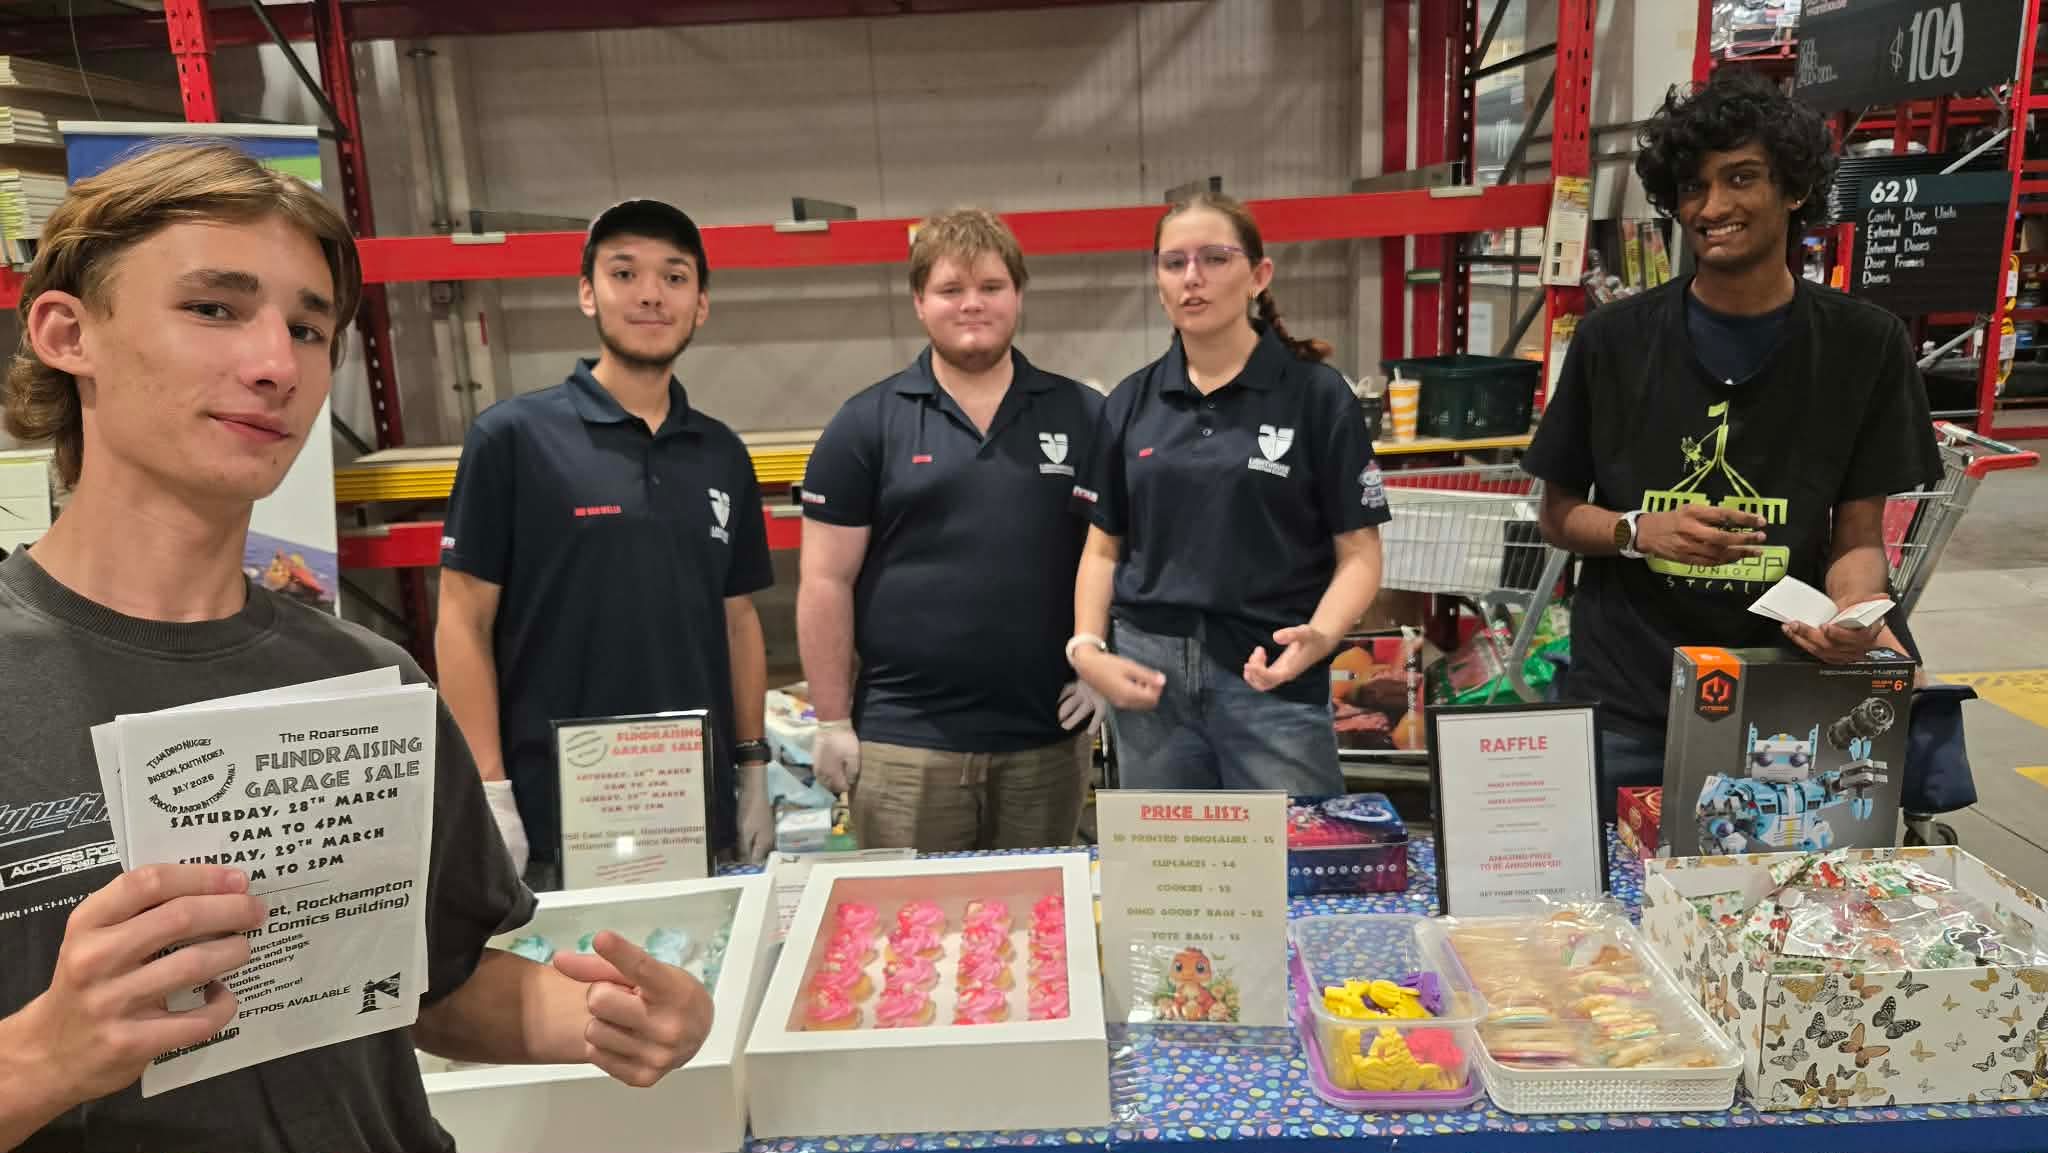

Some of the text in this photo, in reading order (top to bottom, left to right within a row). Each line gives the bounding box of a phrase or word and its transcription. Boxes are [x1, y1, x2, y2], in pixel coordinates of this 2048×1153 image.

[1870, 181, 1900, 203] 62
[1905, 207, 1927, 221] Door
[1867, 222, 1937, 239] External Doors
[1866, 238, 1930, 255] Internal Doors
[1864, 254, 1925, 270] Door Frames
[1862, 270, 1890, 285] Doors
[279, 725, 379, 744] The Roarsome
[1480, 735, 1549, 753] RAFFLE
[201, 748, 225, 763] KOREA
[255, 736, 423, 772] FUNDRAISING
[172, 773, 215, 796] JULY 2026
[244, 760, 420, 798] GARAGE SALE
[170, 805, 279, 828] SATURDAY,
[335, 787, 398, 807] MARCH
[1140, 804, 1249, 821] PRICE LIST:
[229, 814, 353, 842] 9AM TO 4PM
[322, 827, 385, 848] MARCH
[10, 849, 84, 879] ACCESS
[276, 863, 298, 877] TO
[307, 854, 344, 871] 2PM
[296, 879, 413, 912] Rockhampton
[268, 912, 330, 934] Comics
[335, 893, 409, 920] Building)
[250, 932, 304, 955] llectables
[264, 940, 311, 959] and bags
[242, 953, 295, 975] stationery
[229, 974, 261, 990] books
[234, 977, 276, 997] ewares
[244, 976, 304, 1002] much more!
[239, 985, 352, 1020] EFTPOS AVAILABLE
